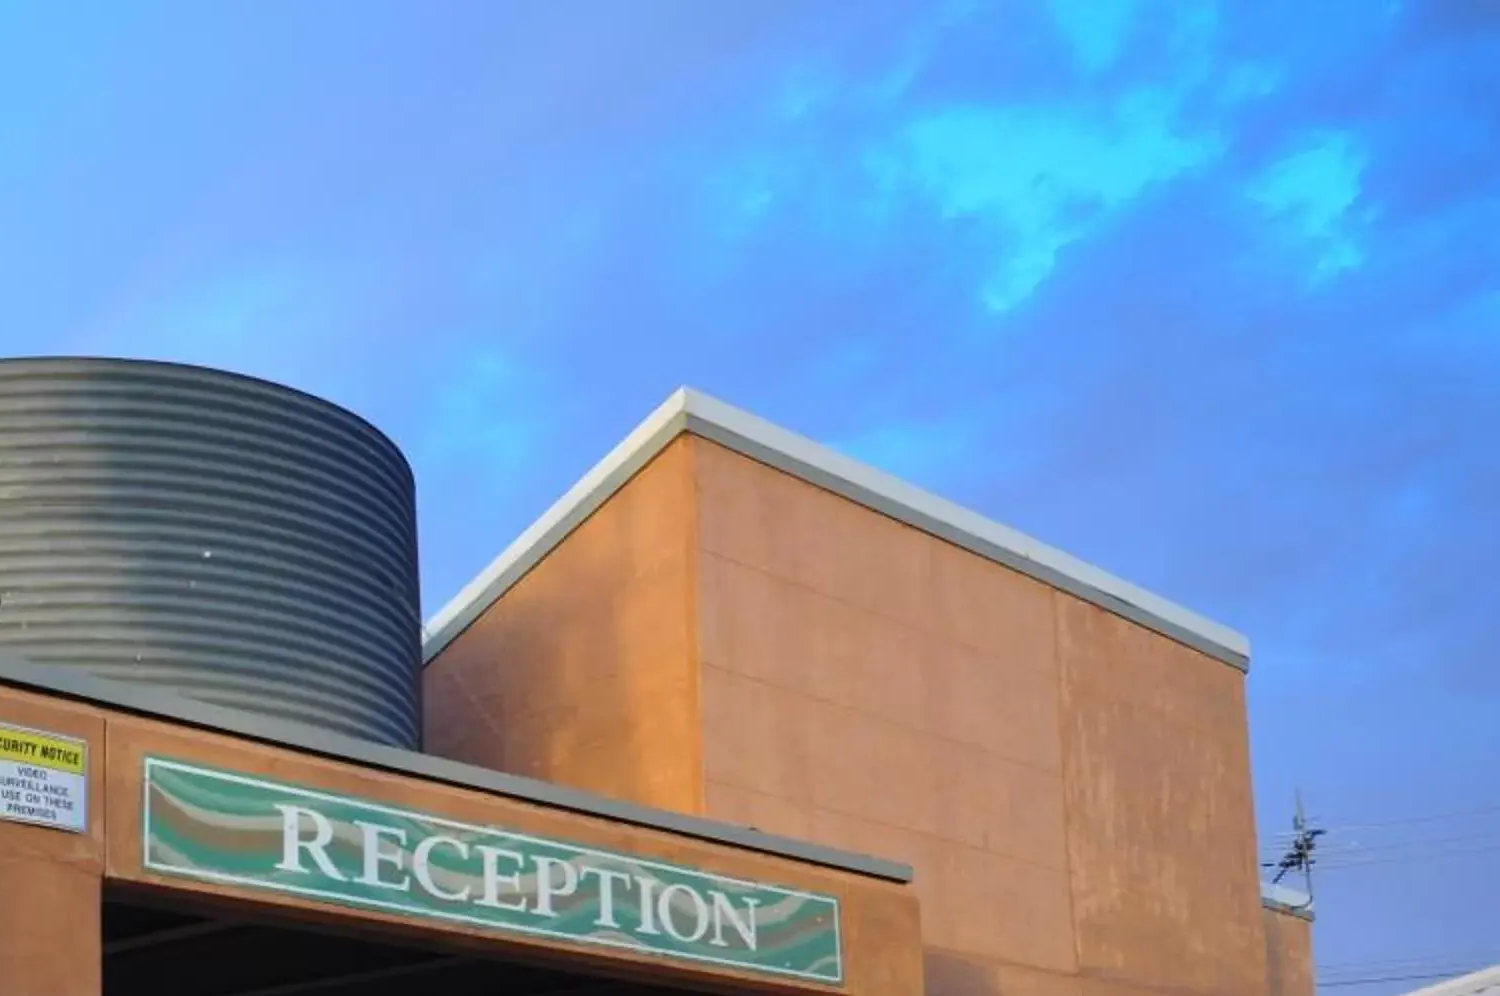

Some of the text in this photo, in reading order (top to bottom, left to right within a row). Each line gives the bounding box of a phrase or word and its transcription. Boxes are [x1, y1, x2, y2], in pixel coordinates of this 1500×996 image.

[40, 744, 79, 765] NOTICE
[17, 766, 47, 780] VIDEO
[1, 789, 20, 801] USE
[44, 795, 74, 810] THESE
[274, 803, 760, 952] RECEPTION
